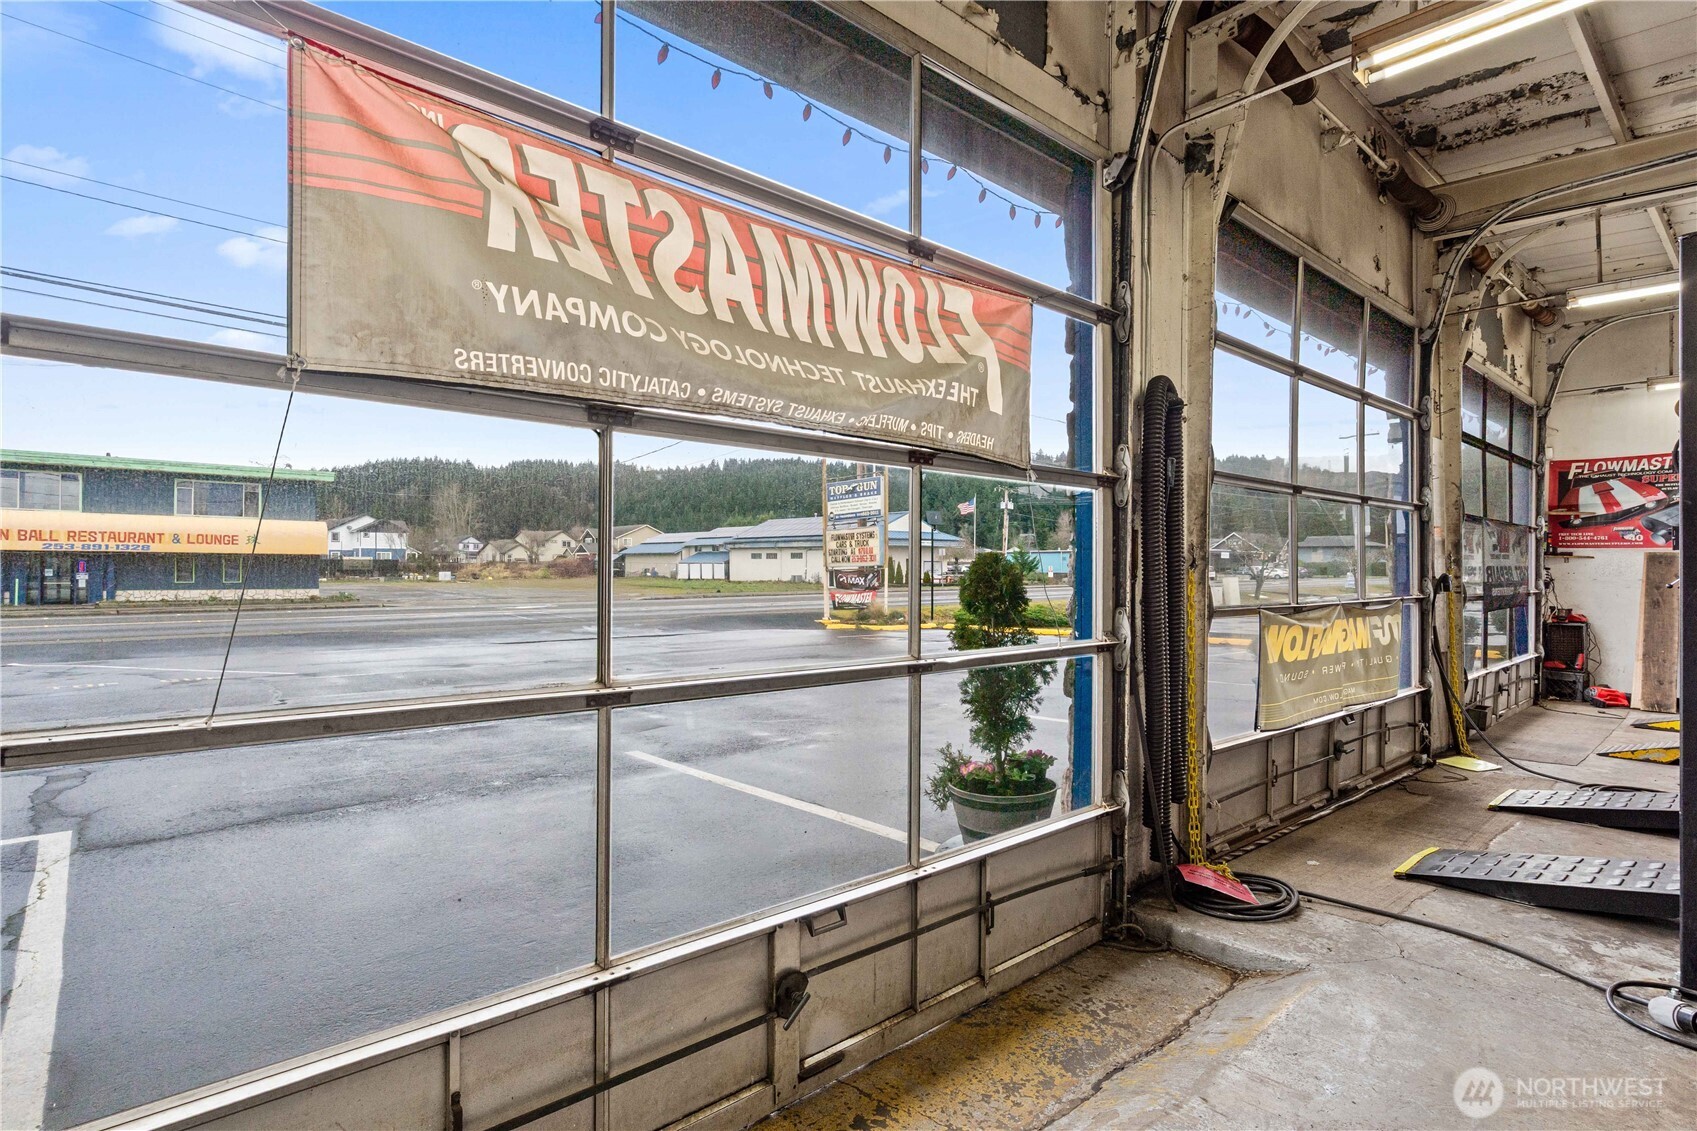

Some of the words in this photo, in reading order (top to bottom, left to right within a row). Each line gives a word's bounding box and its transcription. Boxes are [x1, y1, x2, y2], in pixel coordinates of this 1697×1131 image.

[1568, 457, 1673, 480] FLOWMAST
[1641, 473, 1680, 484] SUPE
[829, 484, 849, 496] TOP
[856, 480, 878, 492] GUN
[17, 530, 59, 542] BALL
[67, 531, 165, 544] RESTAURANT
[172, 533, 181, 545] &
[186, 533, 240, 546] LOUNGE
[855, 531, 876, 540] SYSTEMS
[41, 543, 151, 551] 253-891-1328
[836, 541, 848, 549] CARS
[855, 540, 870, 548] TRUCK
